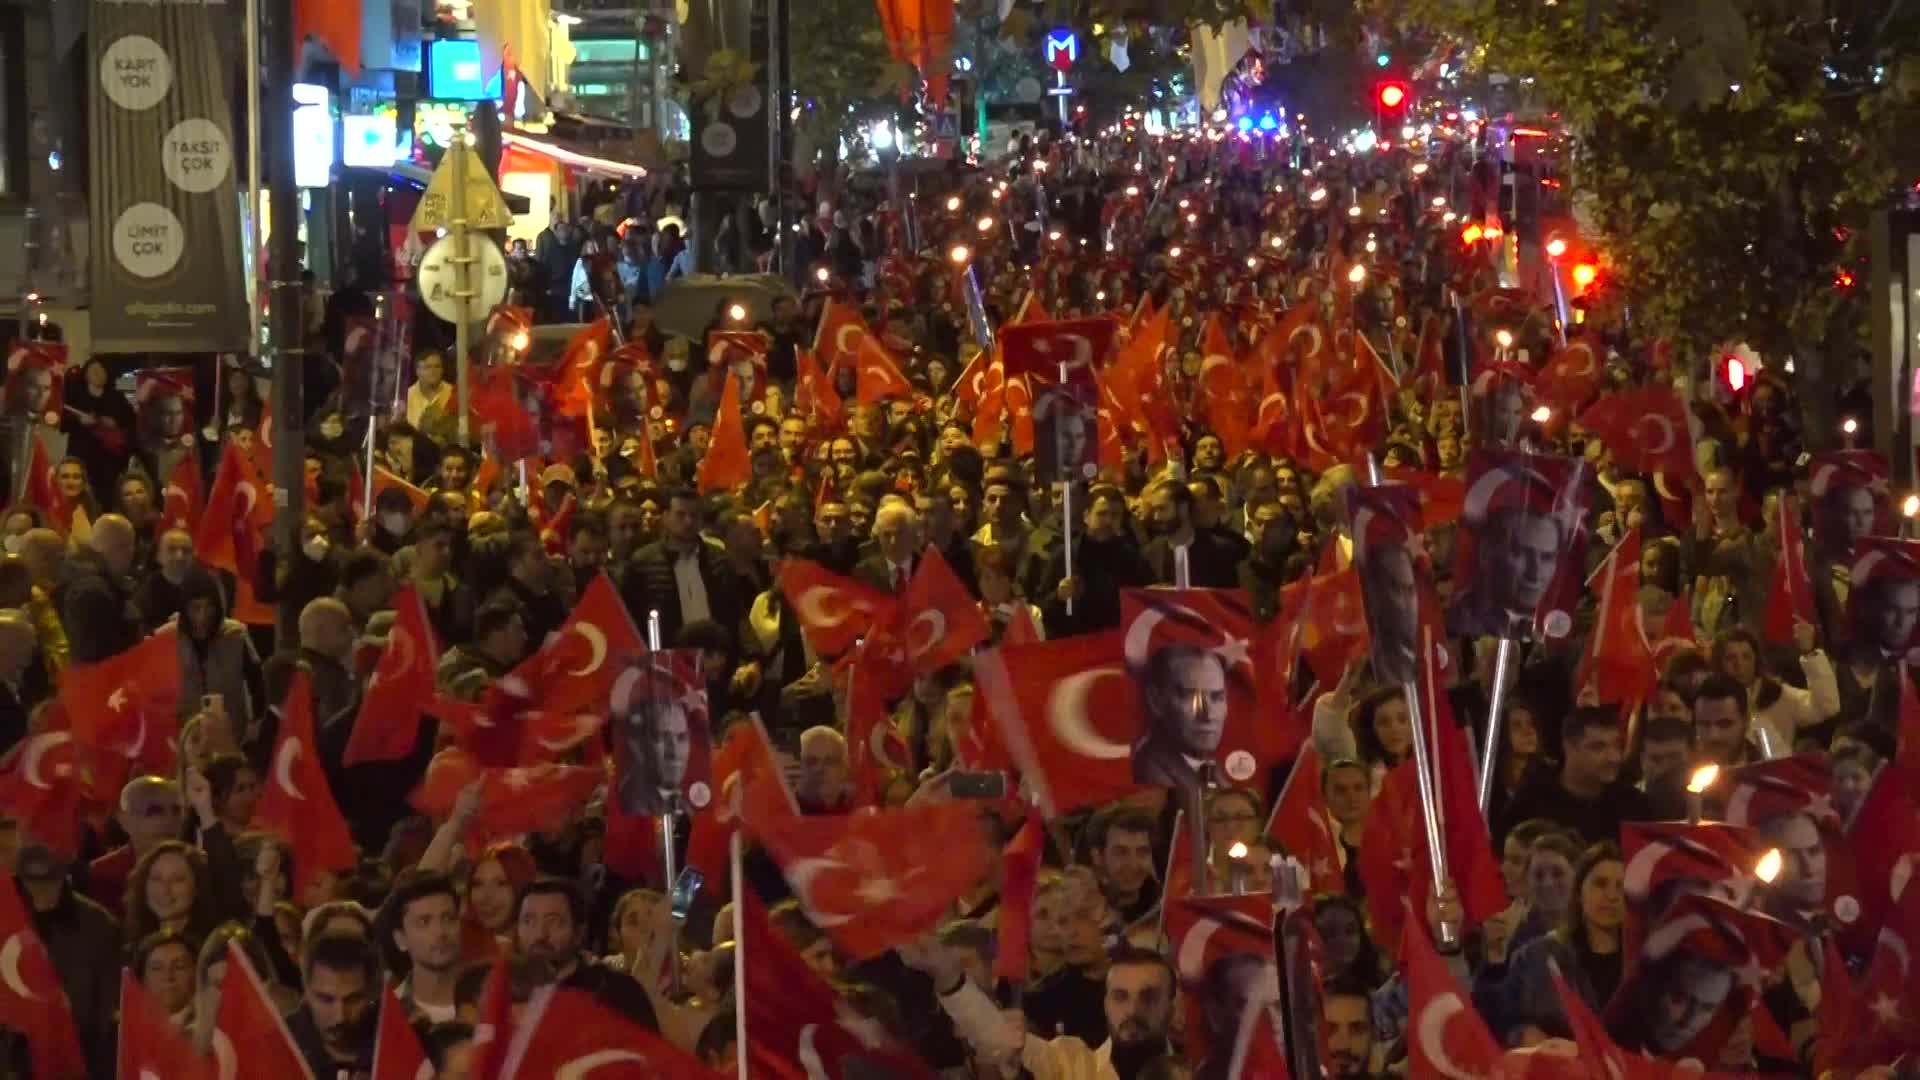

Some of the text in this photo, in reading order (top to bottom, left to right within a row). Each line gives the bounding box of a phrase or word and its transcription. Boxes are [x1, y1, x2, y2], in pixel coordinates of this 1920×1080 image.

[114, 58, 157, 71] KART
[119, 75, 151, 88] YOK
[181, 158, 213, 174] ÇOK
[132, 242, 163, 256] ÇOK
